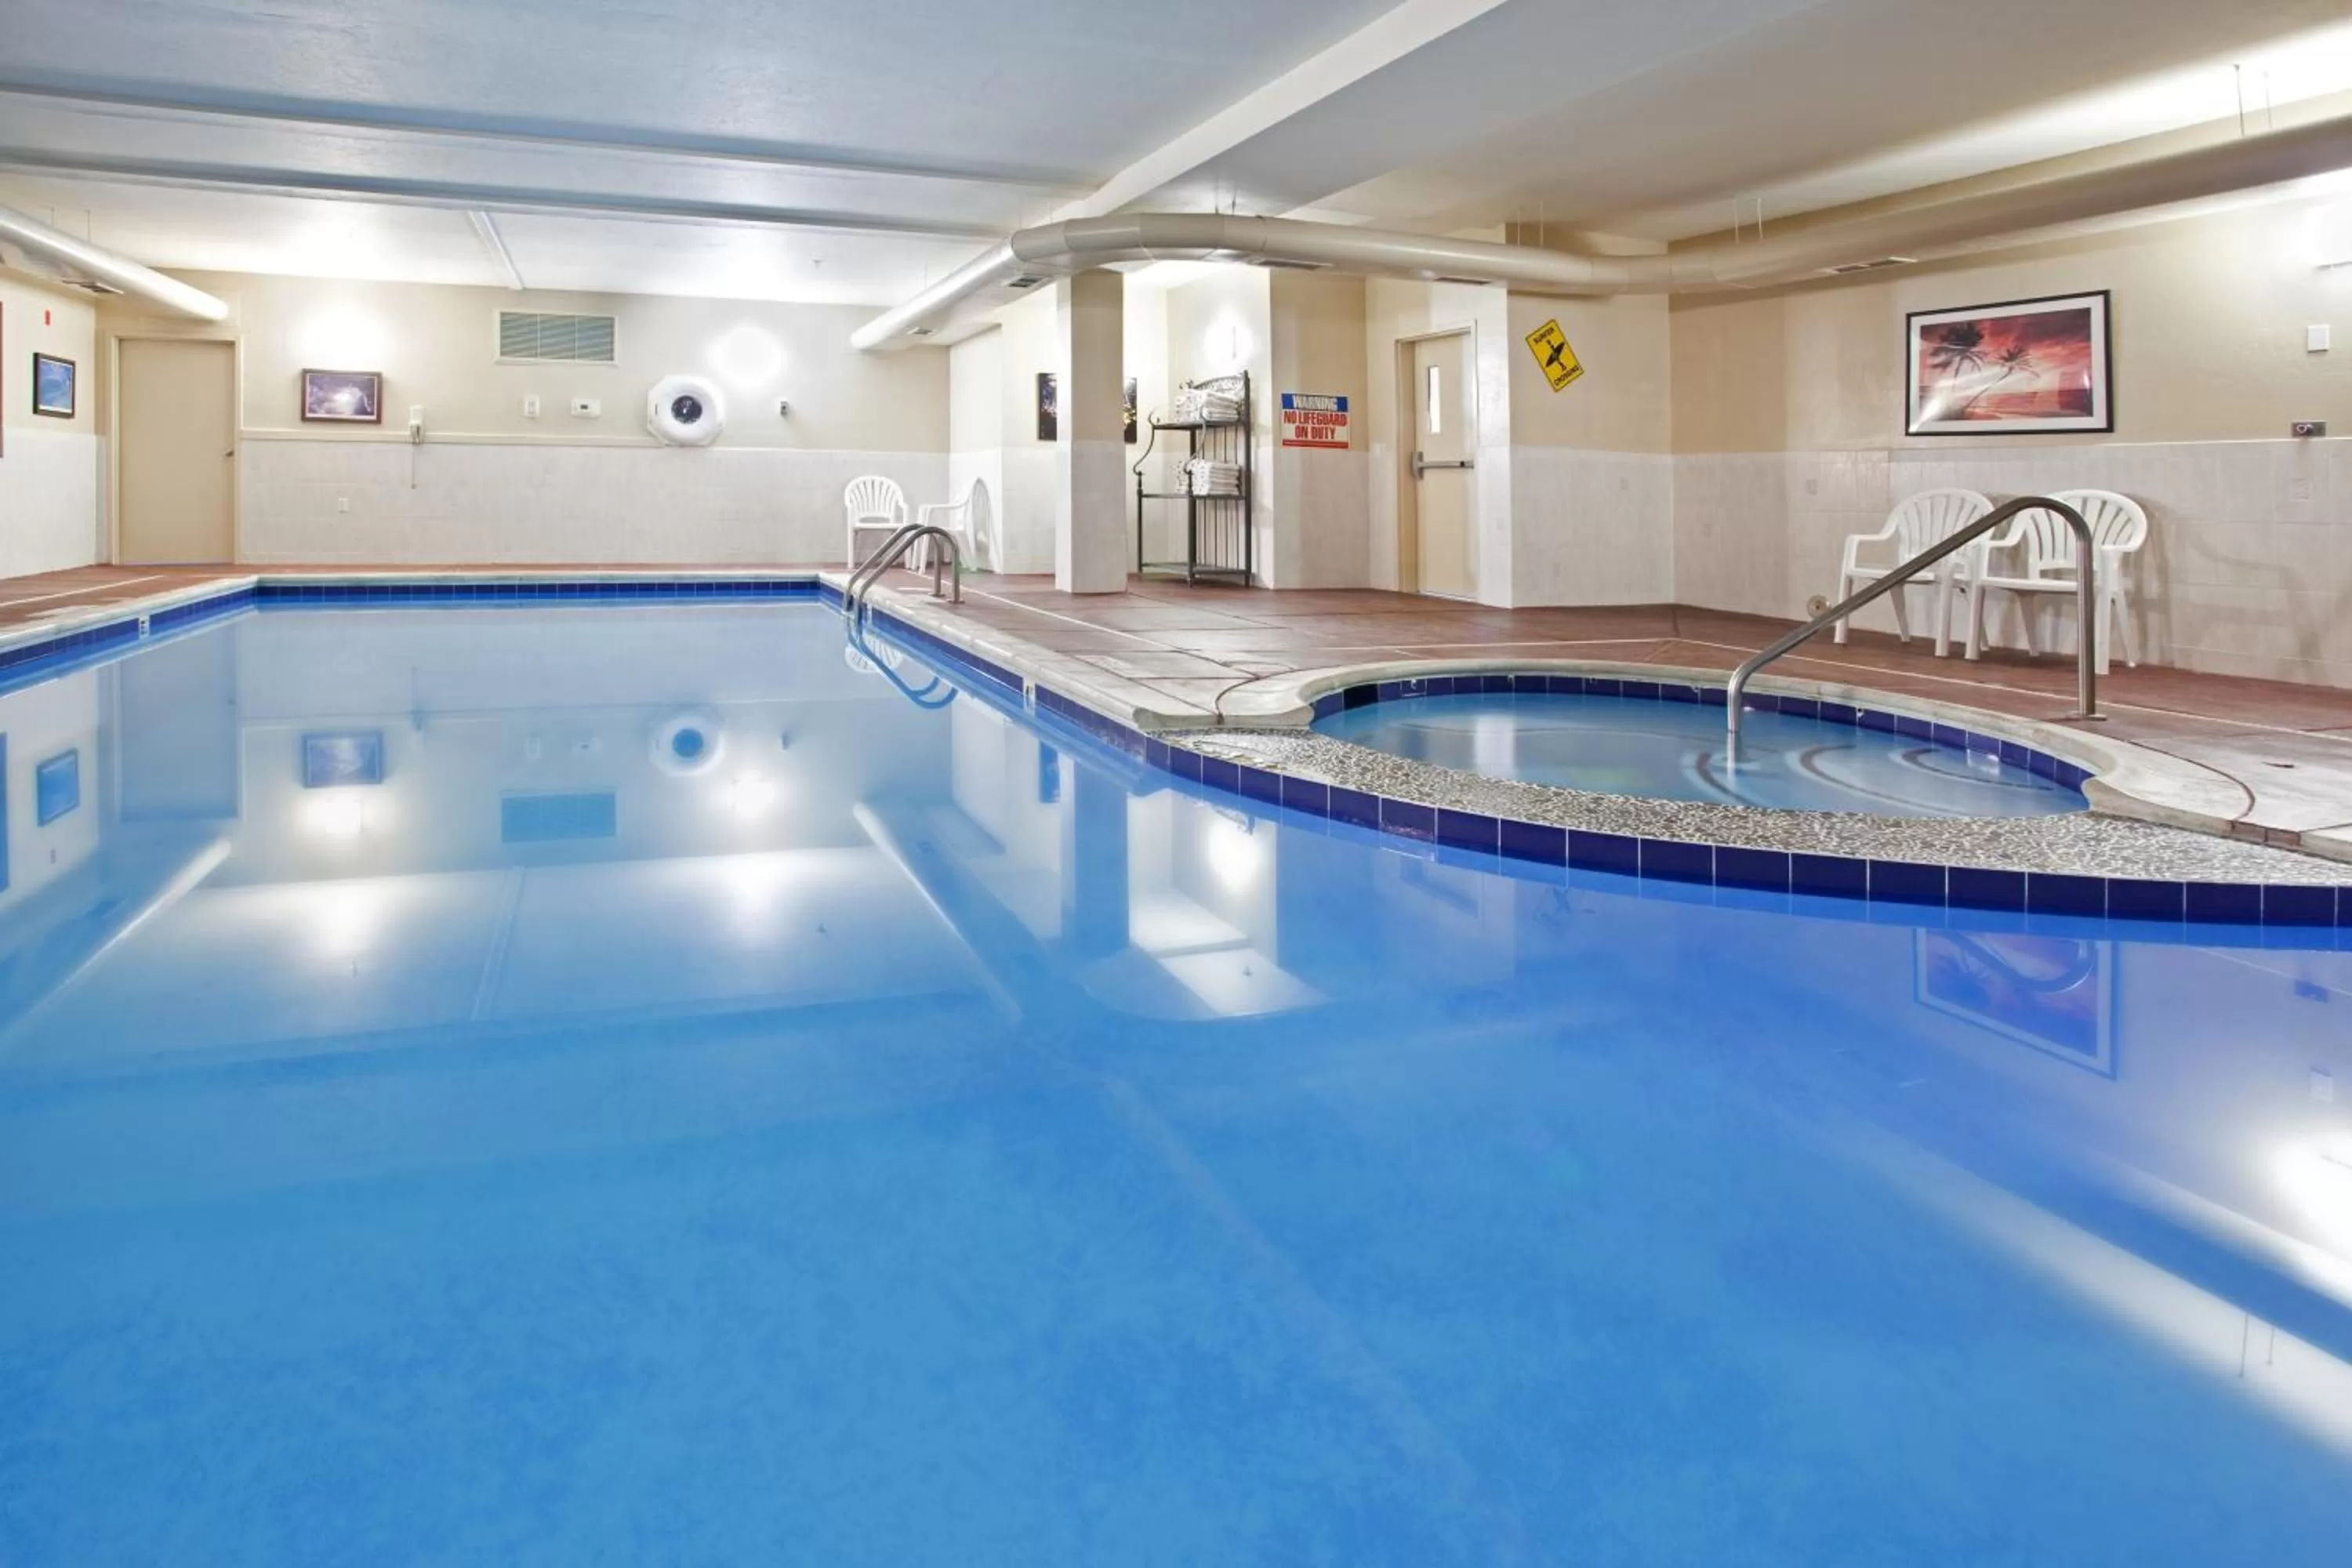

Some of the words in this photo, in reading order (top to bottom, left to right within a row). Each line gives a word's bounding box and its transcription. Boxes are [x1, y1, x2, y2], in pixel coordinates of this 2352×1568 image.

[1292, 395, 1338, 411] WARNING
[1283, 411, 1297, 424] NO
[1298, 412, 1347, 426] LIFEGUARD
[1294, 425, 1308, 439] ON
[1311, 426, 1336, 439] DUTY
